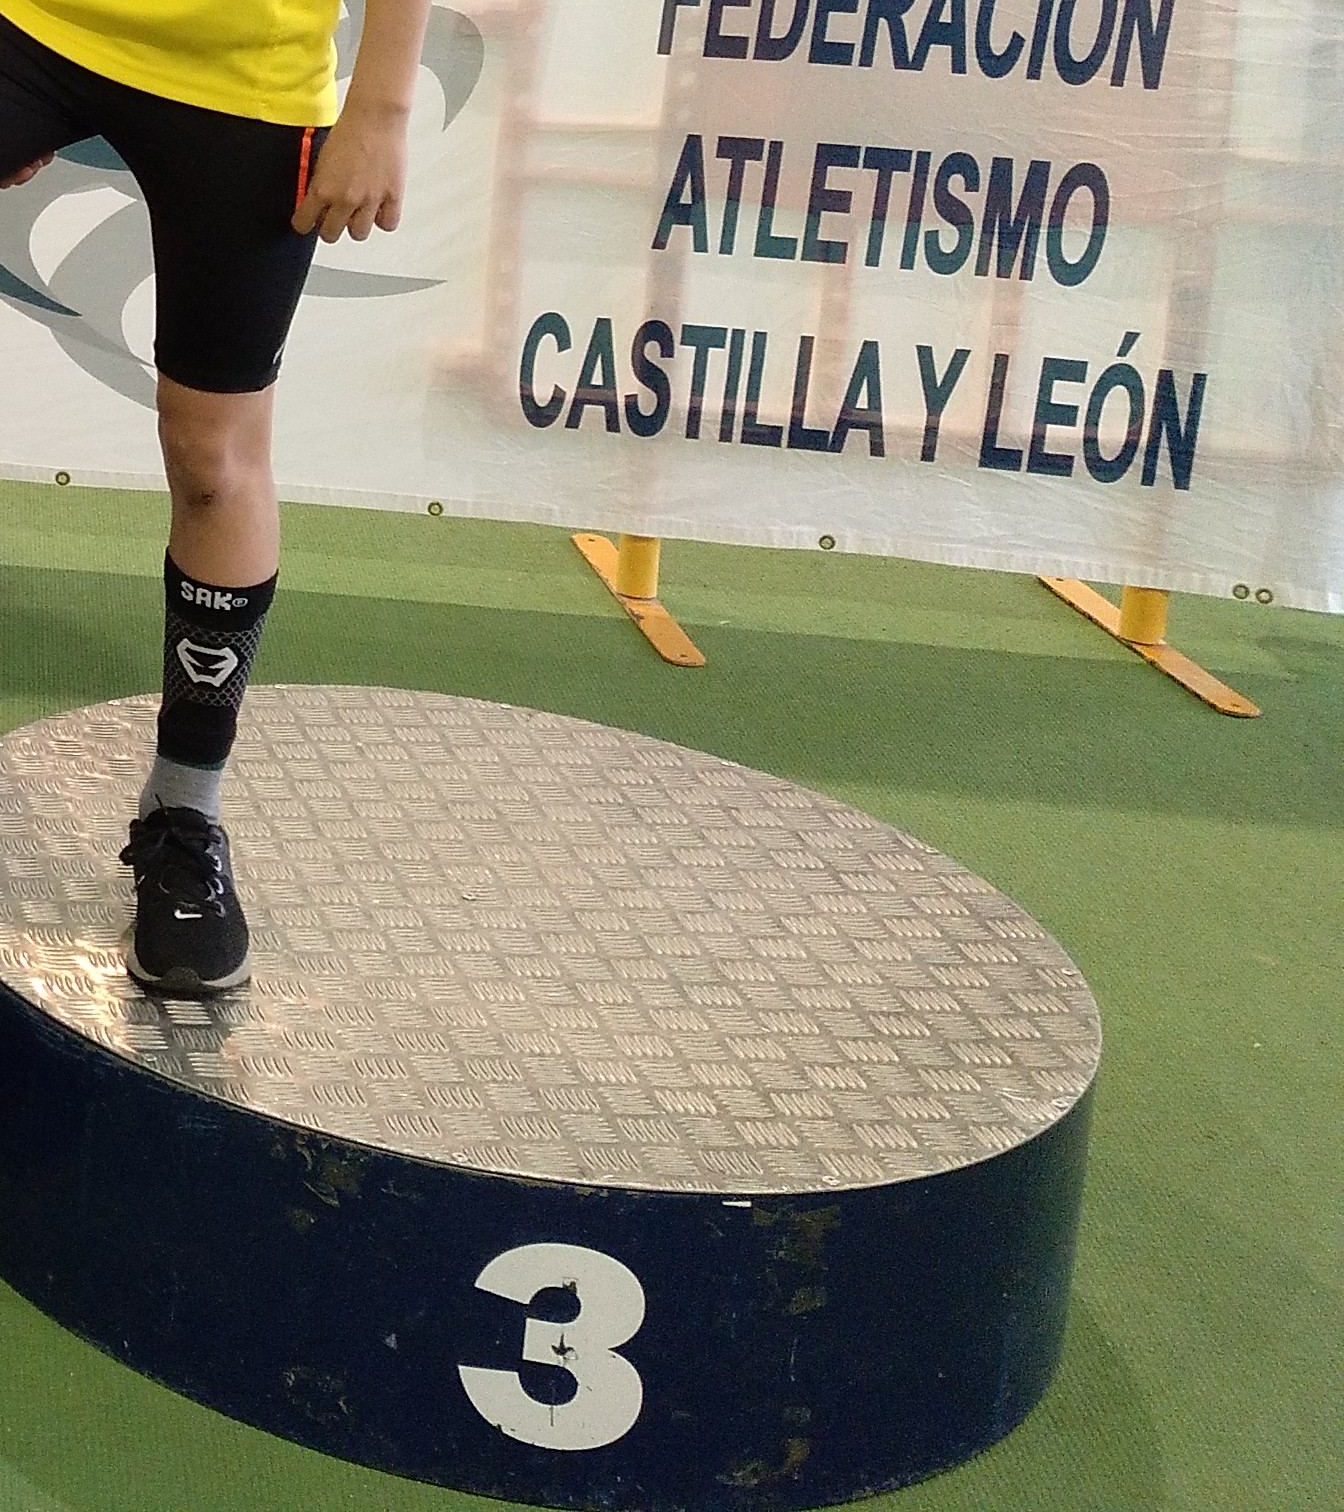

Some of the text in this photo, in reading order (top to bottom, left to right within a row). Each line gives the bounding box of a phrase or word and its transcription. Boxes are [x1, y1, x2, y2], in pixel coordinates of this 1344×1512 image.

[651, 133, 1111, 287] ATLETISMO
[518, 311, 1208, 491] CASTILLA Y LEÓN
[458, 1243, 646, 1451] 3
